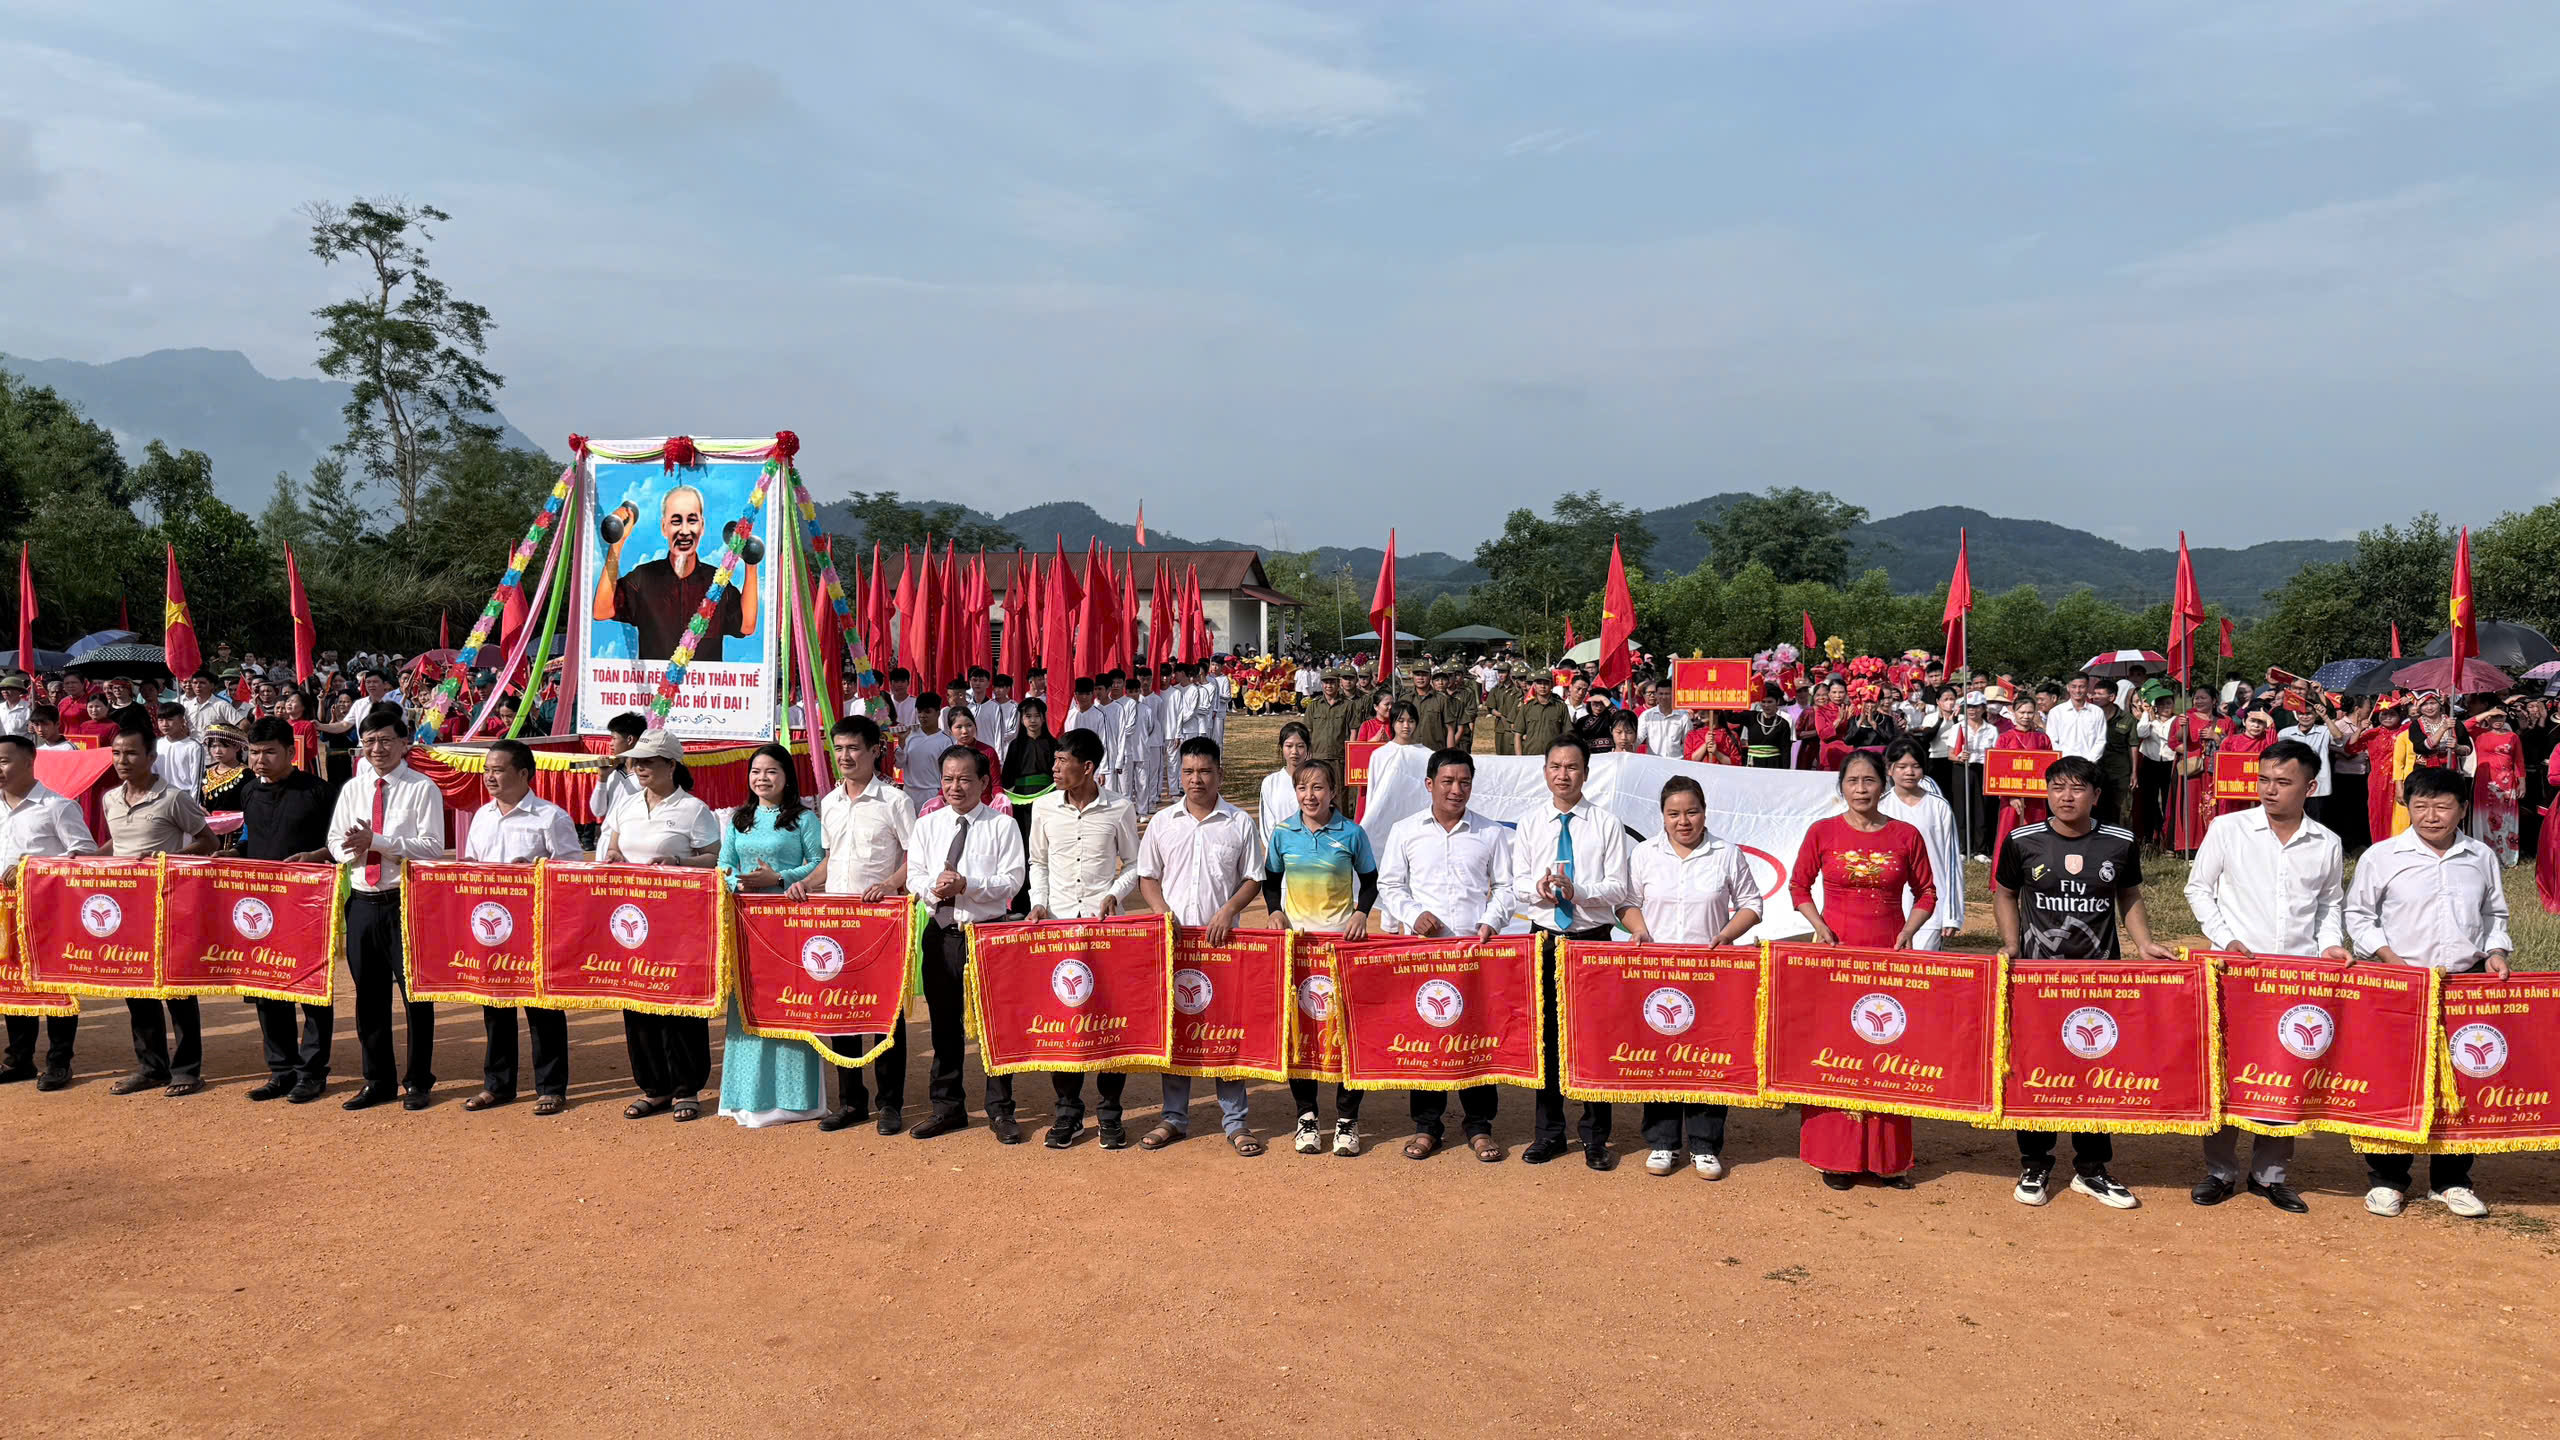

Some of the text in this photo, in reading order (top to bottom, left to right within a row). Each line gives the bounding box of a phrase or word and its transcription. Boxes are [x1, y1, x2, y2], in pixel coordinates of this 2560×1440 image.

[593, 667, 619, 682] TOÀN
[623, 667, 644, 684] DÂN
[708, 670, 736, 686] THÂN
[740, 669, 760, 687] THỂ
[601, 692, 626, 706] THEO
[711, 693, 721, 709] VĨ
[724, 696, 741, 712] ĐẠI
[2060, 880, 2086, 895] Fly
[2034, 892, 2110, 912] Emirates
[62, 944, 150, 964] Lưu Niệm
[1048, 942, 1063, 952] THỨ
[1068, 941, 1087, 951] NĂM
[200, 944, 298, 969] Lưu Niệm
[1354, 956, 1367, 965] BTC
[1396, 951, 1409, 961] THỂ
[1428, 948, 1440, 959] THỂ
[1443, 950, 1460, 959] THAO
[1496, 948, 1515, 957] HÀNH
[1582, 954, 1755, 969] BTC ĐẠI HỘI THỂ DỤC THỂ THAO XÃ BẰNG HÀNH
[580, 954, 678, 980] Lưu Niệm
[1412, 964, 1429, 972] THỨ
[1436, 963, 1455, 972] NĂM
[1458, 962, 1478, 972] 2026
[1622, 968, 1714, 981] LẦN THỨ I NĂM 2026
[1788, 956, 1973, 978] BTC ĐẠI HỘI THỂ DỤC THỂ THAO XÃ BẰNG HÀNH
[1830, 971, 1929, 989] LẦN THỨ I NĂM 2026
[2011, 971, 2184, 985] ĐẠI HỘI THỂ DỤC THỂ THAO XÃ BẰNG HÀNH
[2227, 966, 2407, 991] ĐẠI HỘI THỂ DỤC THỂ THAO XÃ BẰNG HÀNH
[776, 986, 879, 1009] Lưu Niệm
[2038, 986, 2139, 998] LẦN THỨ I NĂM 2026
[2254, 981, 2359, 1000] LẦN THỨ I NĂM 2026
[2445, 990, 2463, 1001] DỤC
[2466, 986, 2482, 999] THỂ
[2484, 989, 2506, 998] THAO
[2509, 987, 2522, 998] XÃ
[2444, 1003, 2528, 1015] THỨ I NĂM 2026
[1027, 1014, 1129, 1034] Lưu Niệm
[1036, 1039, 1064, 1048] Tháng
[1071, 1040, 1093, 1048] năm
[1097, 1034, 1120, 1045] 2026
[1388, 1034, 1500, 1055] Lưu Niệm
[1396, 1058, 1428, 1068] Tháng
[1467, 1054, 1491, 1064] 2026
[1609, 1042, 1733, 1067] Lưu Niệm
[1811, 1047, 1945, 1080] Lưu Niệm
[1618, 1068, 1653, 1078] Tháng
[1657, 1068, 1664, 1076] 5
[1696, 1069, 1724, 1079] 2026
[1820, 1073, 1933, 1092] Tháng 5 năm 2026
[2023, 1066, 2162, 1093] Lưu Niệm
[2232, 1063, 2369, 1094] Lưu Niệm
[2032, 1094, 2150, 1105] Tháng 5 năm 2026
[2244, 1091, 2287, 1105] Tháng
[2291, 1096, 2299, 1104] 5
[2324, 1096, 2356, 1108] 2026
[2476, 1085, 2551, 1110] Niệm
[2467, 1115, 2474, 1124] 5
[2478, 1115, 2506, 1123] năm
[2510, 1112, 2541, 1122] 2026
